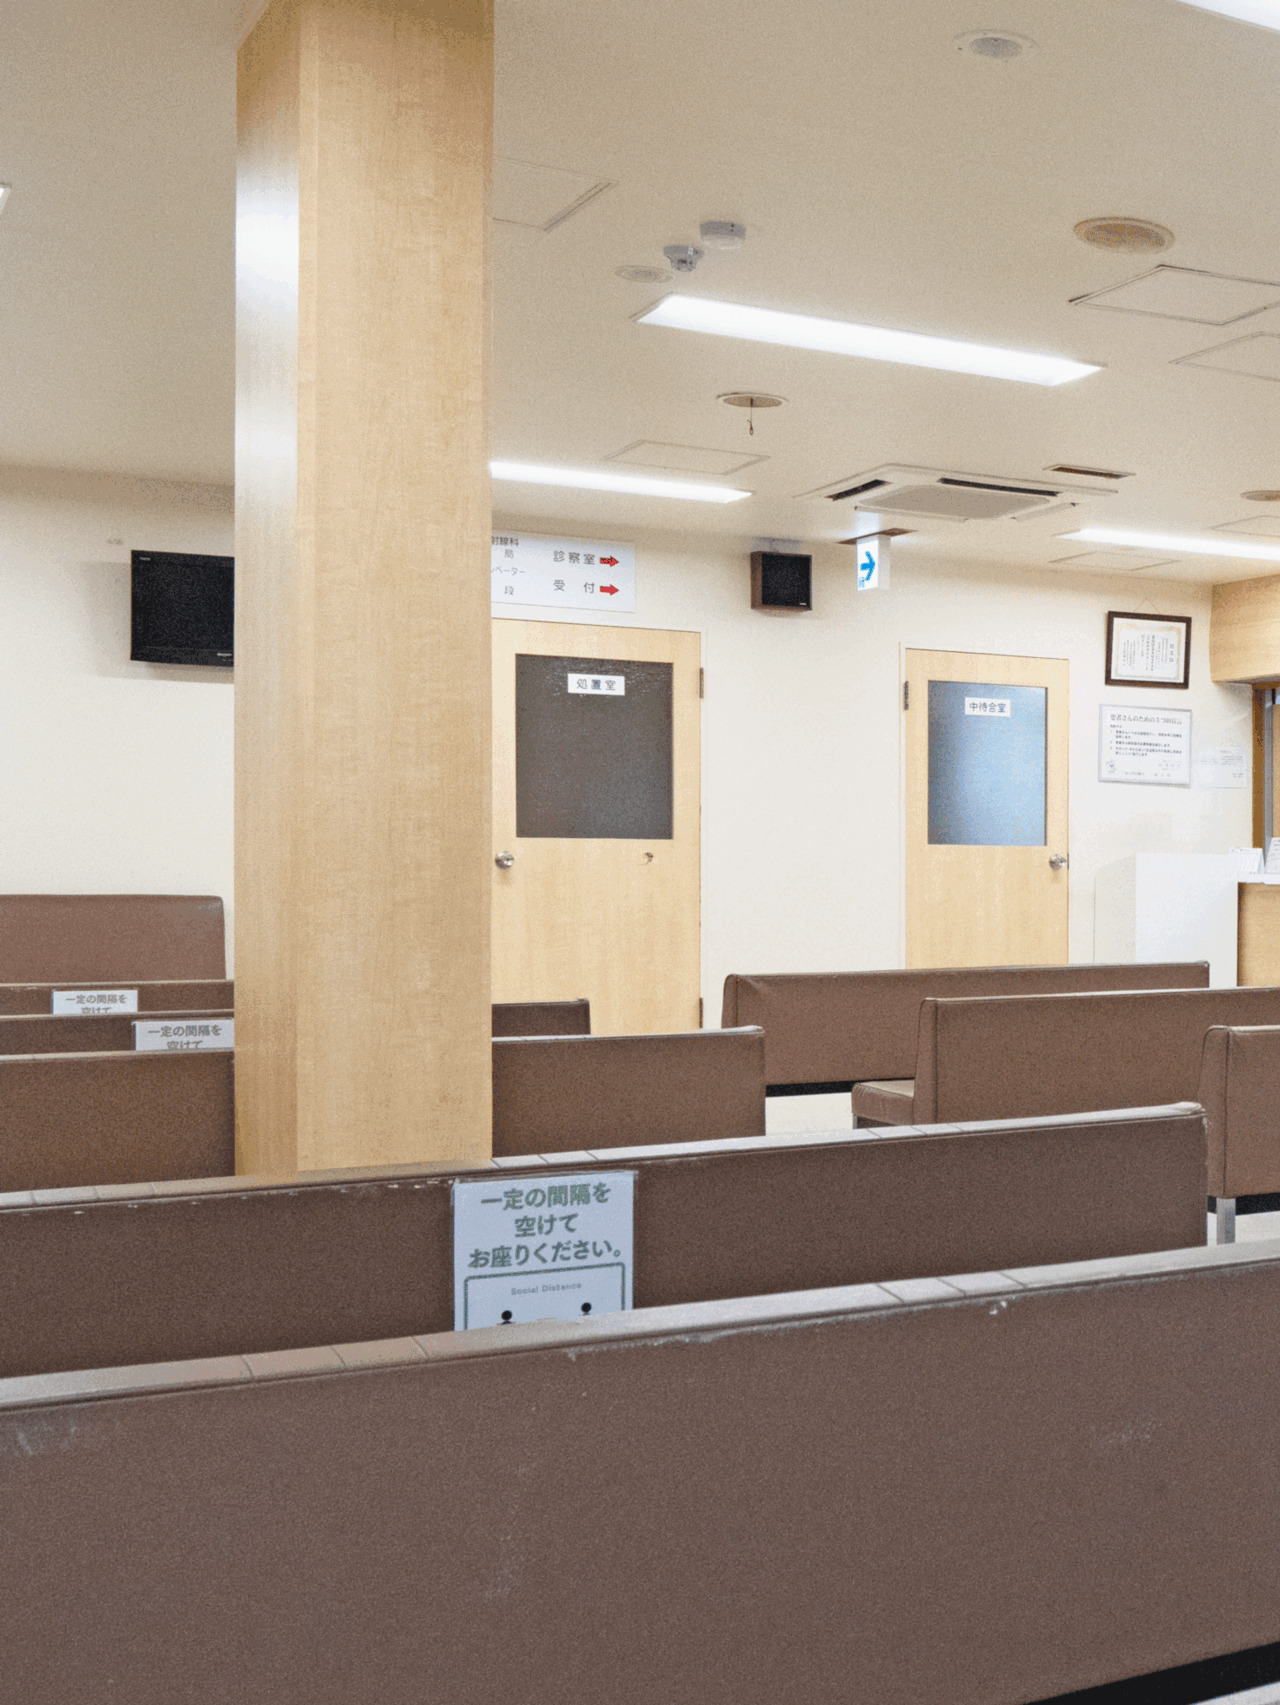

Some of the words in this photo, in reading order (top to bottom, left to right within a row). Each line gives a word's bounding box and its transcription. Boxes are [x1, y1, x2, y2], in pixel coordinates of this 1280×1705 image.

[553, 550, 596, 566] 診察室
[576, 678, 616, 691] 処置室
[969, 701, 1006, 713] 中待合室
[65, 994, 127, 1004] 一定の間隔を
[147, 1025, 222, 1038] 一定の間隔を
[480, 1182, 611, 1211] 一定の間隔を
[514, 1213, 579, 1238] 空けて
[468, 1240, 621, 1269] お座りください。
[511, 1286, 539, 1296] Social
[541, 1282, 583, 1293] Distance
